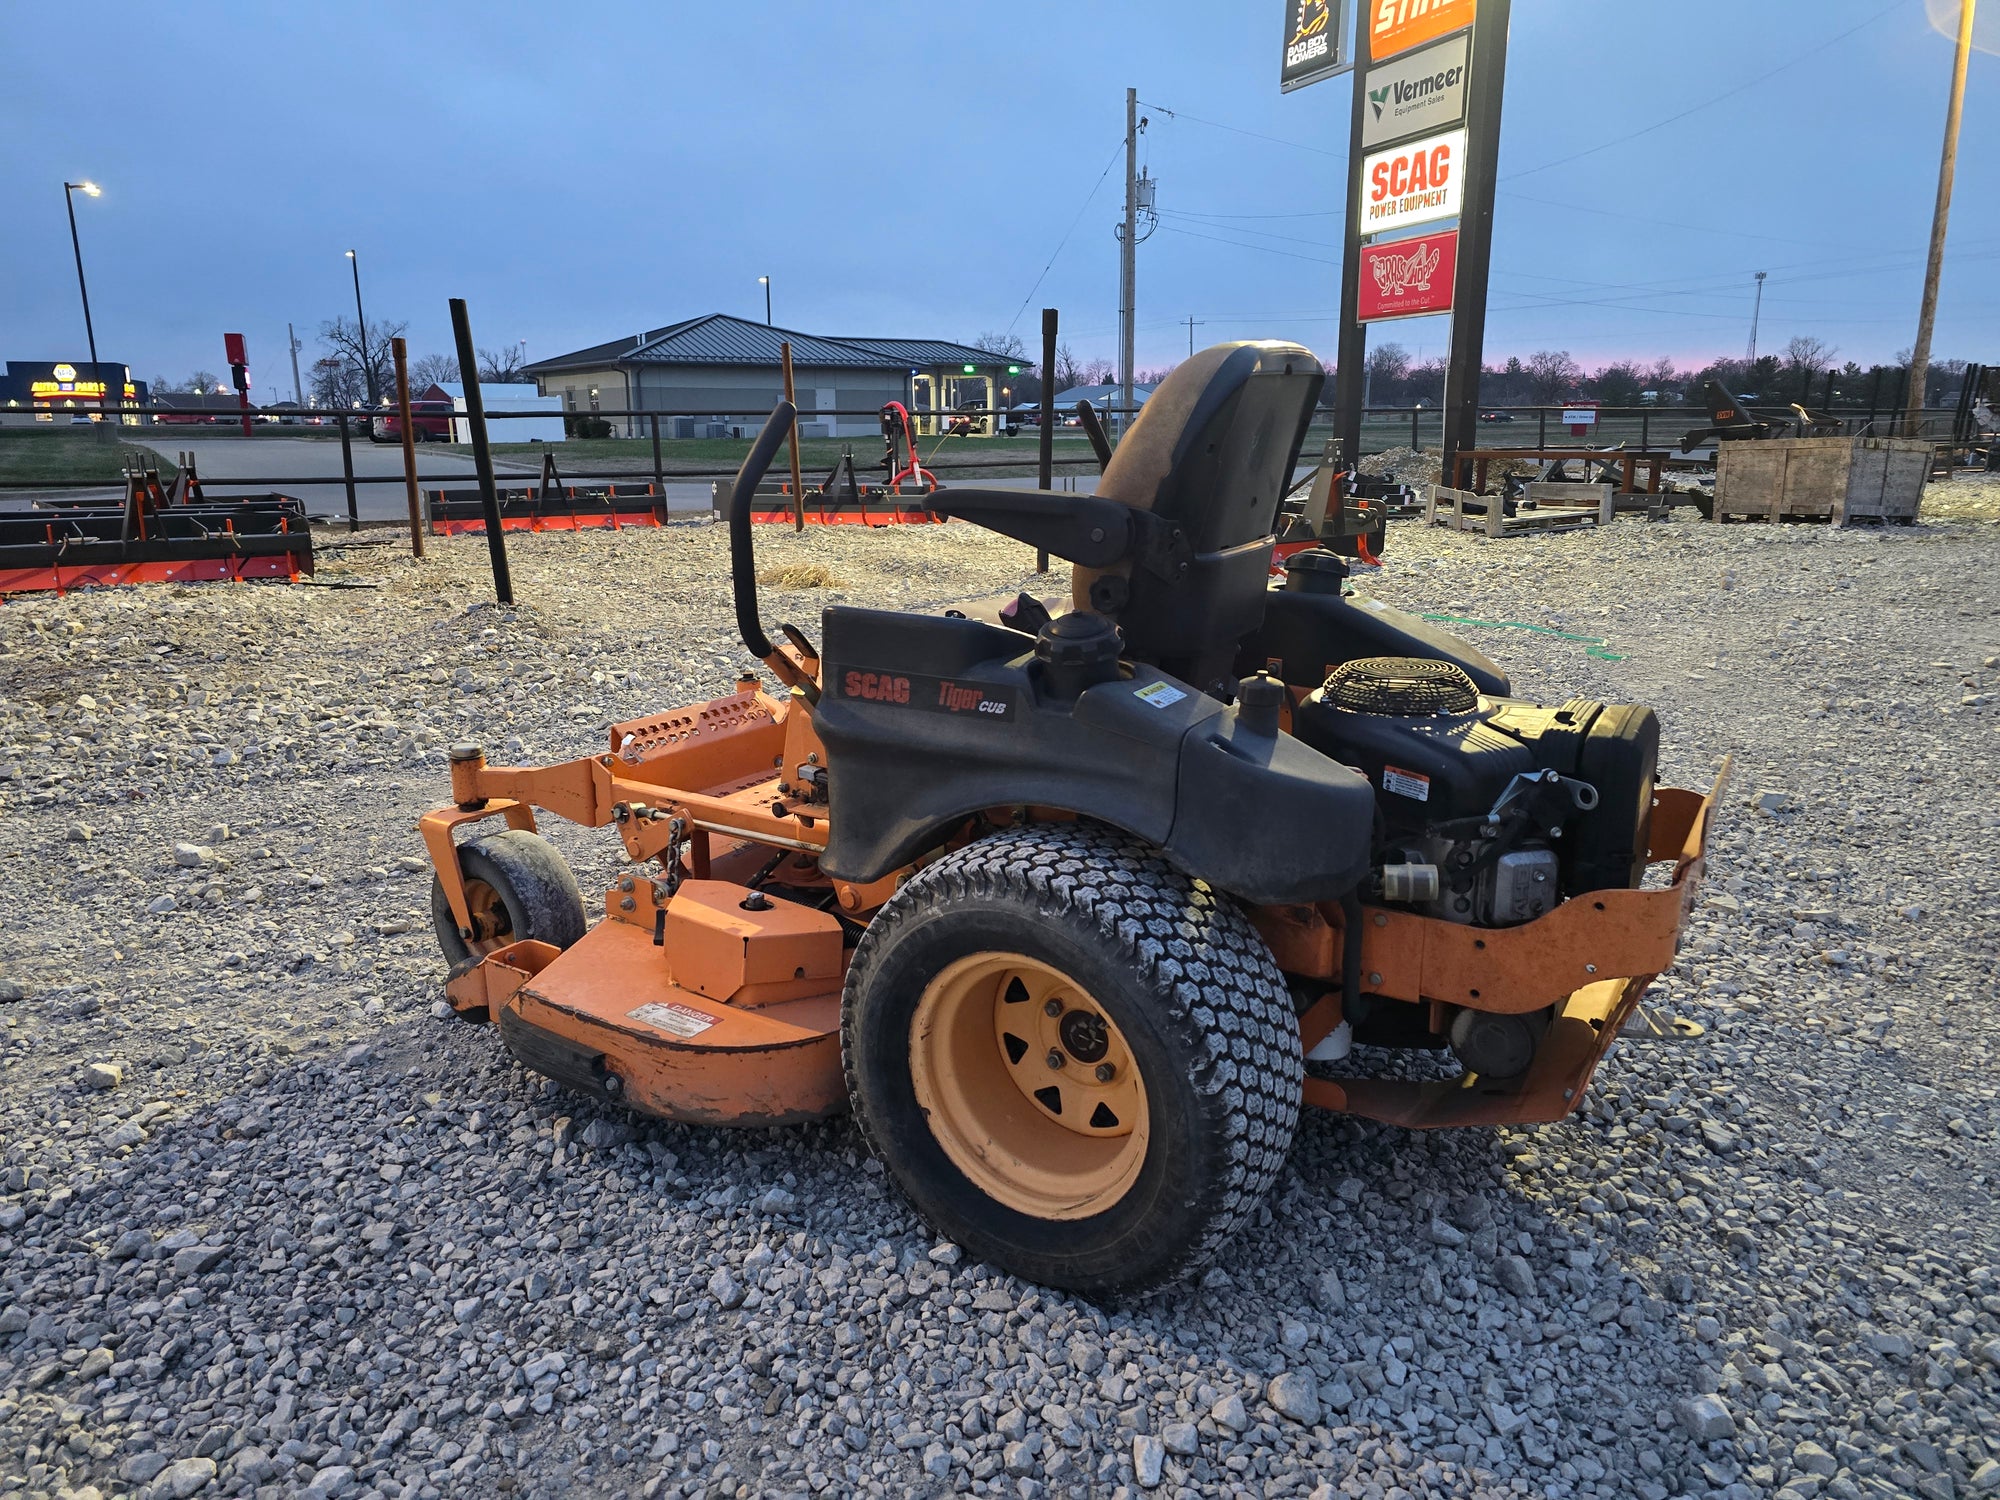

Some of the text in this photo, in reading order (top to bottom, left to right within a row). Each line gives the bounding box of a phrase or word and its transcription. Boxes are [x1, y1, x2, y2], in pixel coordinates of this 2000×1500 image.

[1286, 43, 1328, 68] MOWERS
[1287, 32, 1328, 56] BAD BOY
[1393, 64, 1463, 105] Vermeer
[1394, 93, 1445, 117] Equipment Sales
[1371, 144, 1450, 202] SCAG
[1369, 189, 1448, 220] POWER EQUIPMENT
[1377, 300, 1404, 310] Committed
[1411, 298, 1420, 306] the
[31, 381, 59, 391] AUTO
[844, 671, 1007, 714] SCAG Tiger CUB
[671, 1005, 715, 1023] DANGER
